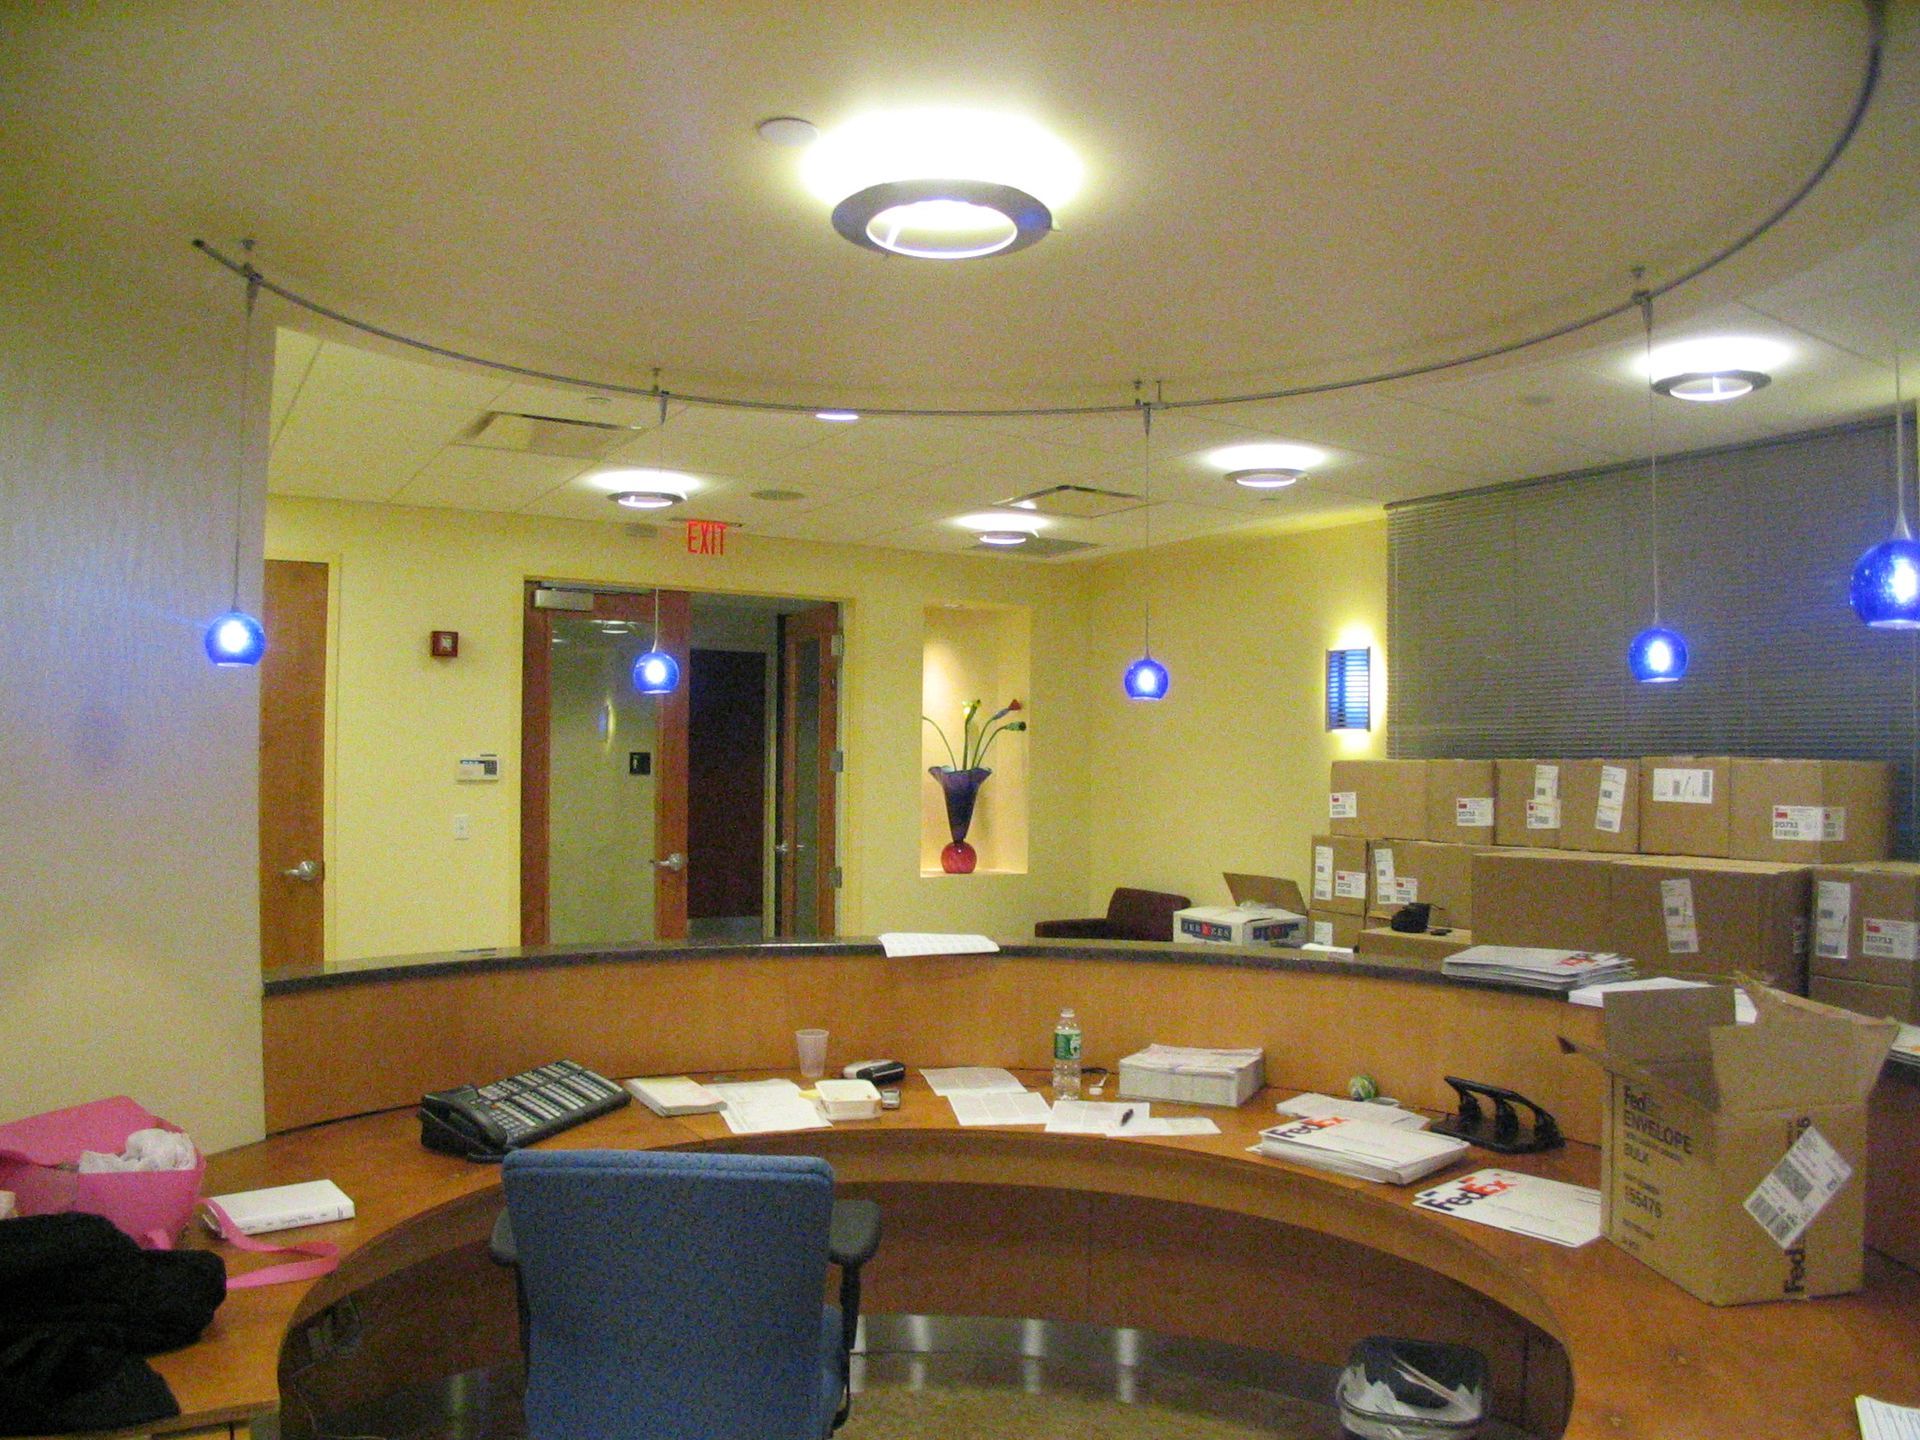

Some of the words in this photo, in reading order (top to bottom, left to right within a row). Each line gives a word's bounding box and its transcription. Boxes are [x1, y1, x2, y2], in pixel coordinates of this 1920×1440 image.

[687, 520, 727, 555] EXIT
[1266, 1116, 1346, 1138] FedEx
[1624, 1109, 1693, 1155] ENVELOPE
[1420, 1179, 1519, 1211] FedEx
